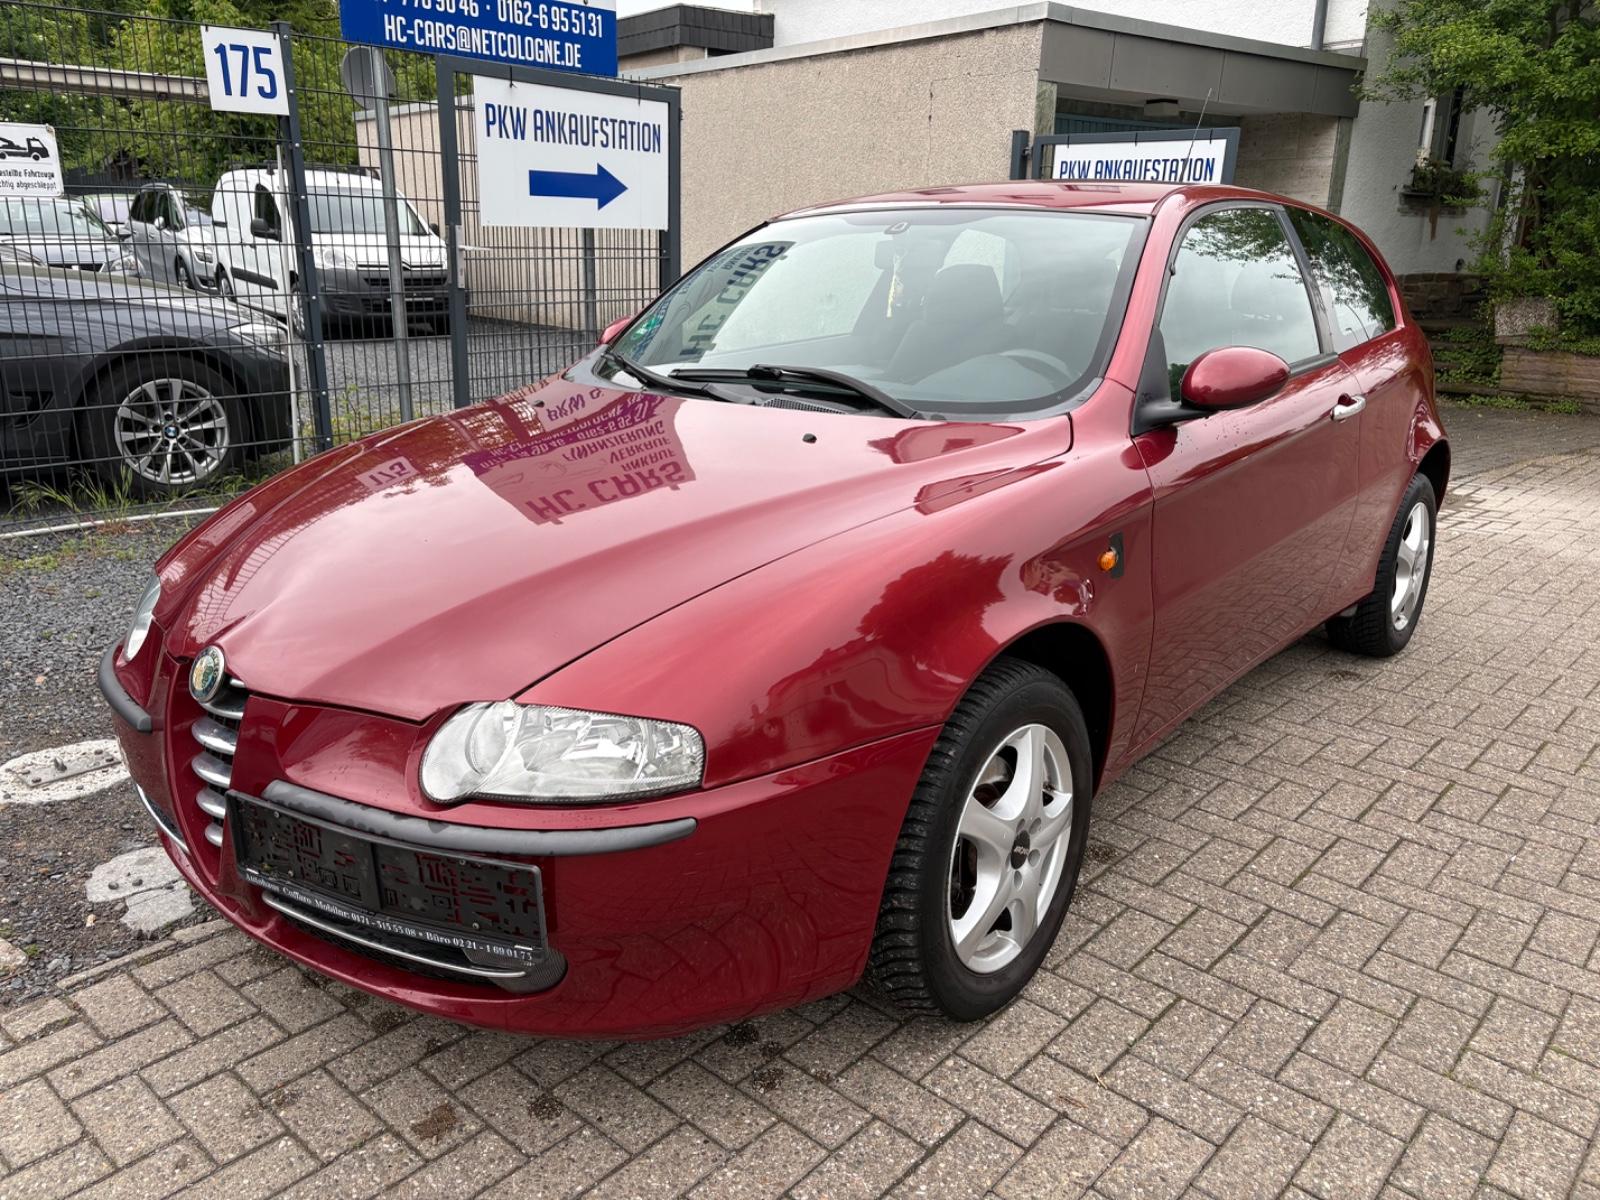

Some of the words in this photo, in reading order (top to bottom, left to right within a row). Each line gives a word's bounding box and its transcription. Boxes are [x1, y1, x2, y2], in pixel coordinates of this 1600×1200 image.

[459, 0, 479, 17] 46
[384, 14, 582, 68] HC-CARS@NETCOLOGNE.DE
[214, 43, 278, 99] 175
[485, 103, 527, 141] PKW
[534, 109, 661, 153] ANKAUFSTATION
[24, 169, 55, 180] Fahrzeuge
[1060, 159, 1091, 179] PKW
[1095, 158, 1216, 182] ANKAUFSTATION
[17, 180, 57, 190] abgeschleppt
[351, 912, 370, 925] 0171
[426, 931, 451, 945] Büro
